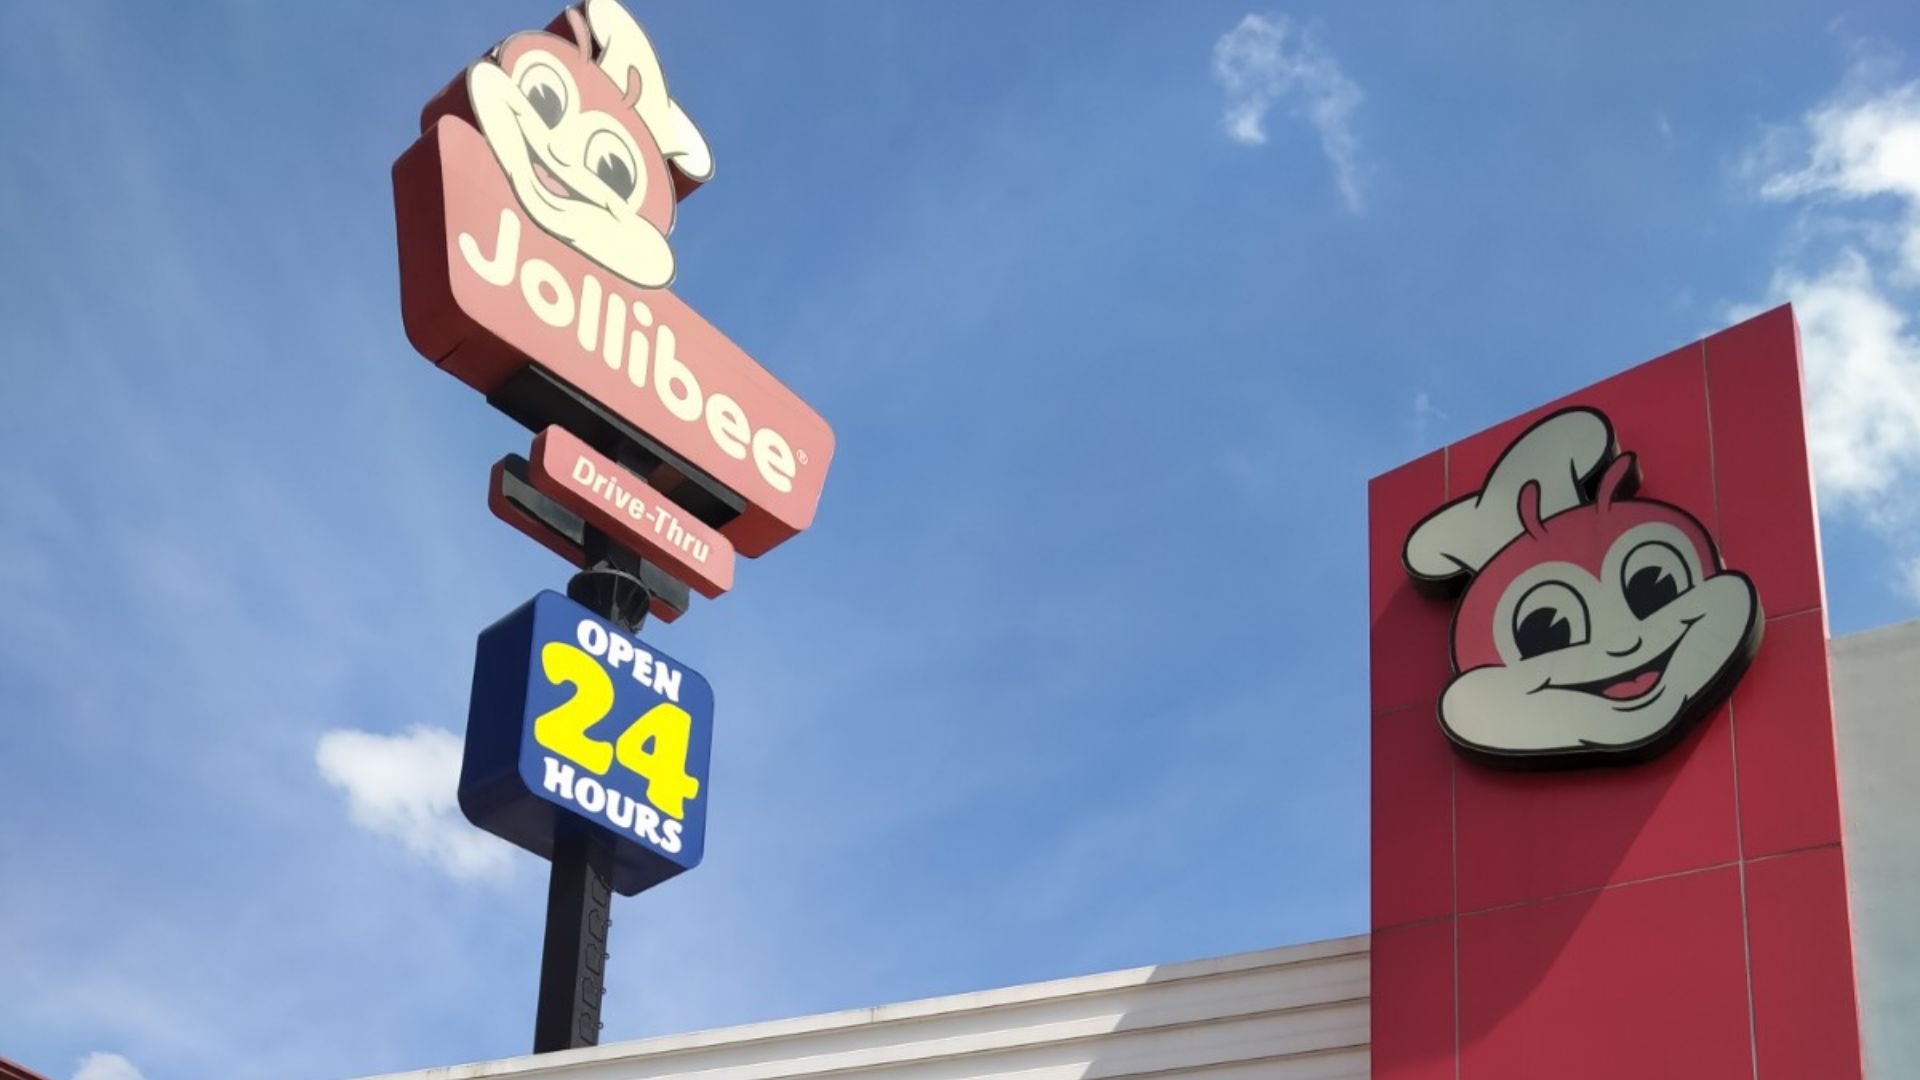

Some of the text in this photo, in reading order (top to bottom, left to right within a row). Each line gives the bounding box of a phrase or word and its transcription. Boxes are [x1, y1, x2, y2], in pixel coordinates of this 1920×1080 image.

[571, 455, 710, 563] Drive-Thru
[576, 618, 682, 703] OPEN
[534, 641, 700, 820] 24
[543, 756, 683, 854] HOURS
